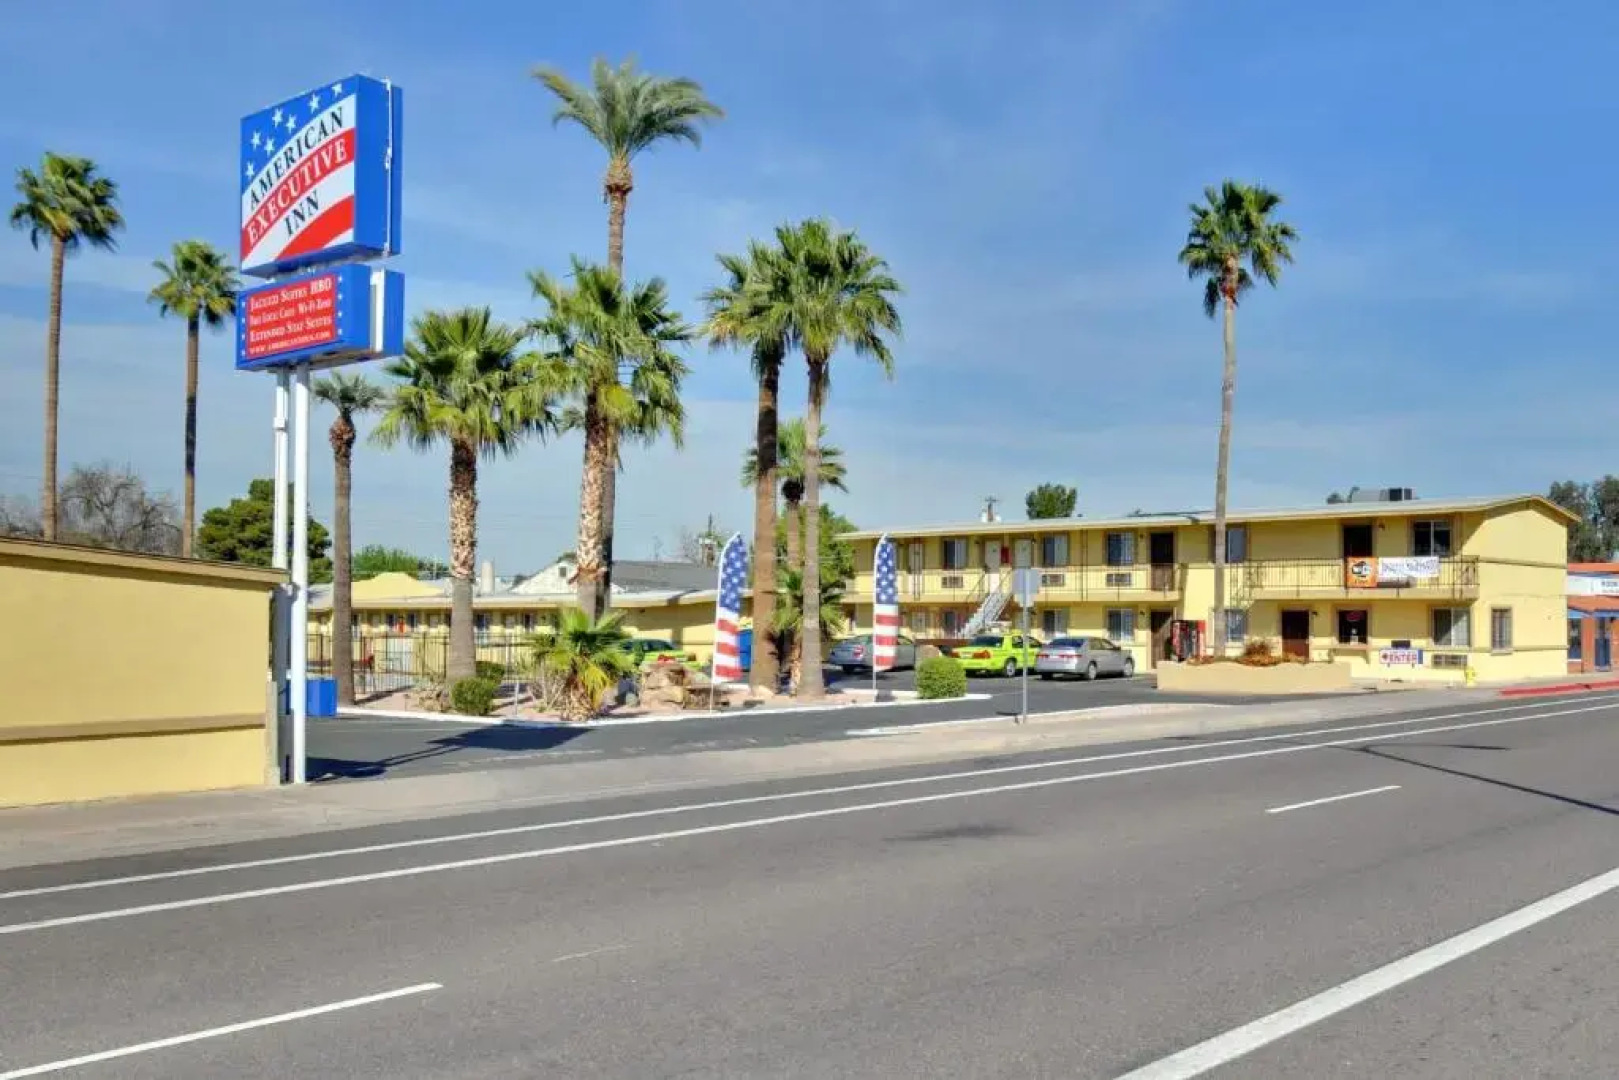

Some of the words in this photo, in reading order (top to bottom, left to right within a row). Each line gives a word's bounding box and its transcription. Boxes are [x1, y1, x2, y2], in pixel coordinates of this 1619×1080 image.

[247, 138, 347, 244] EXECUTIVE
[250, 106, 344, 210] AMERICAN
[283, 190, 321, 237] INN
[310, 277, 332, 295] HBO
